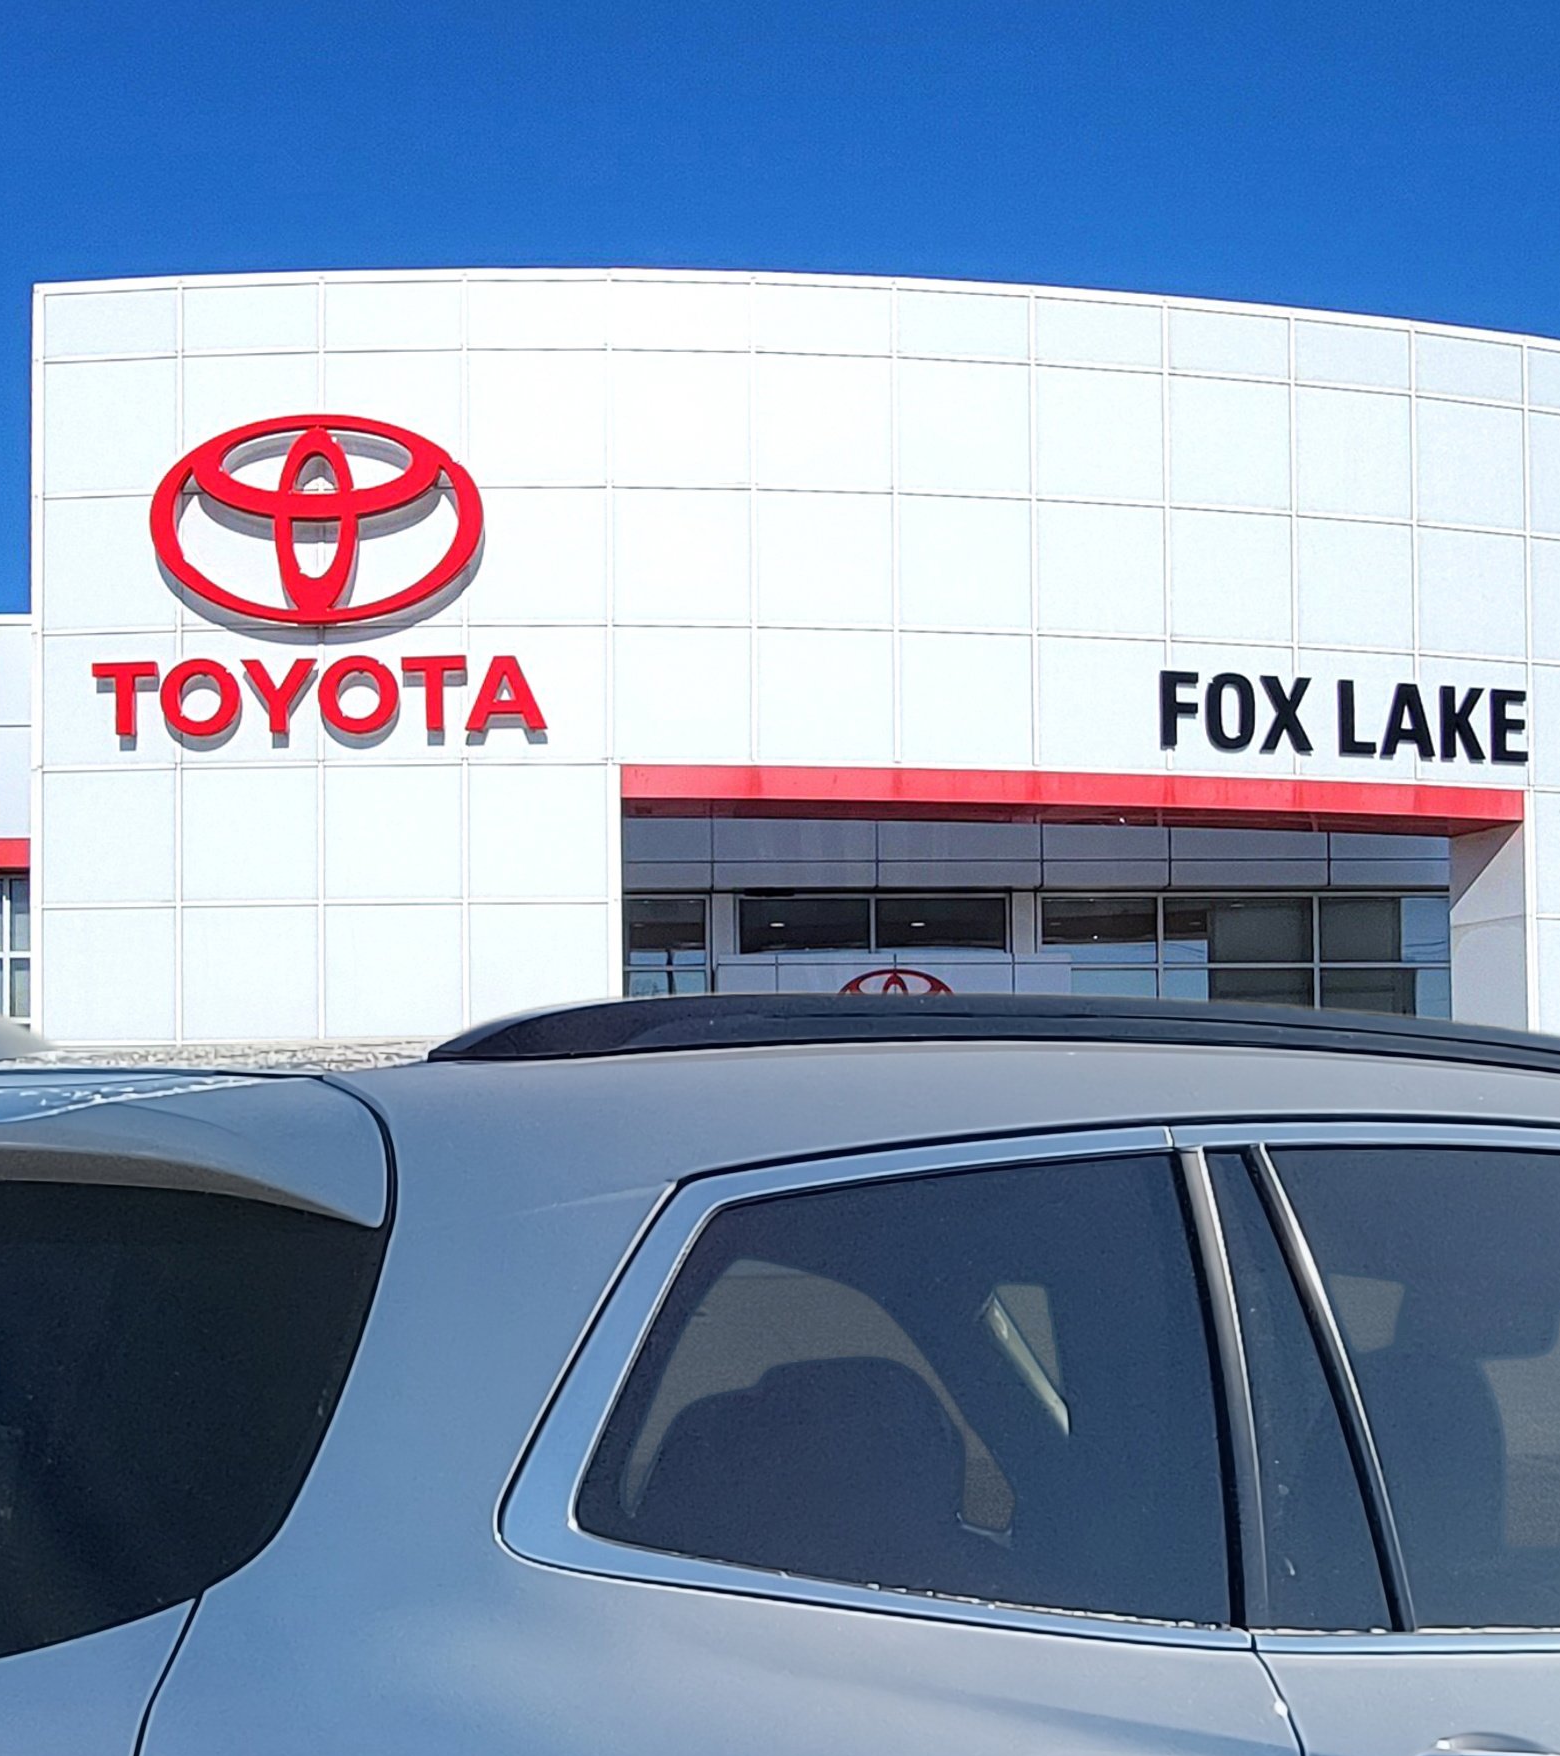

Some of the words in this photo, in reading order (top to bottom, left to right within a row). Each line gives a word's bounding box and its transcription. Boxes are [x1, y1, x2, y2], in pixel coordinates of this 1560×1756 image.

[92, 654, 548, 748] TOYOTA
[1159, 670, 1313, 755] FOX
[1337, 679, 1529, 764] LAKE
